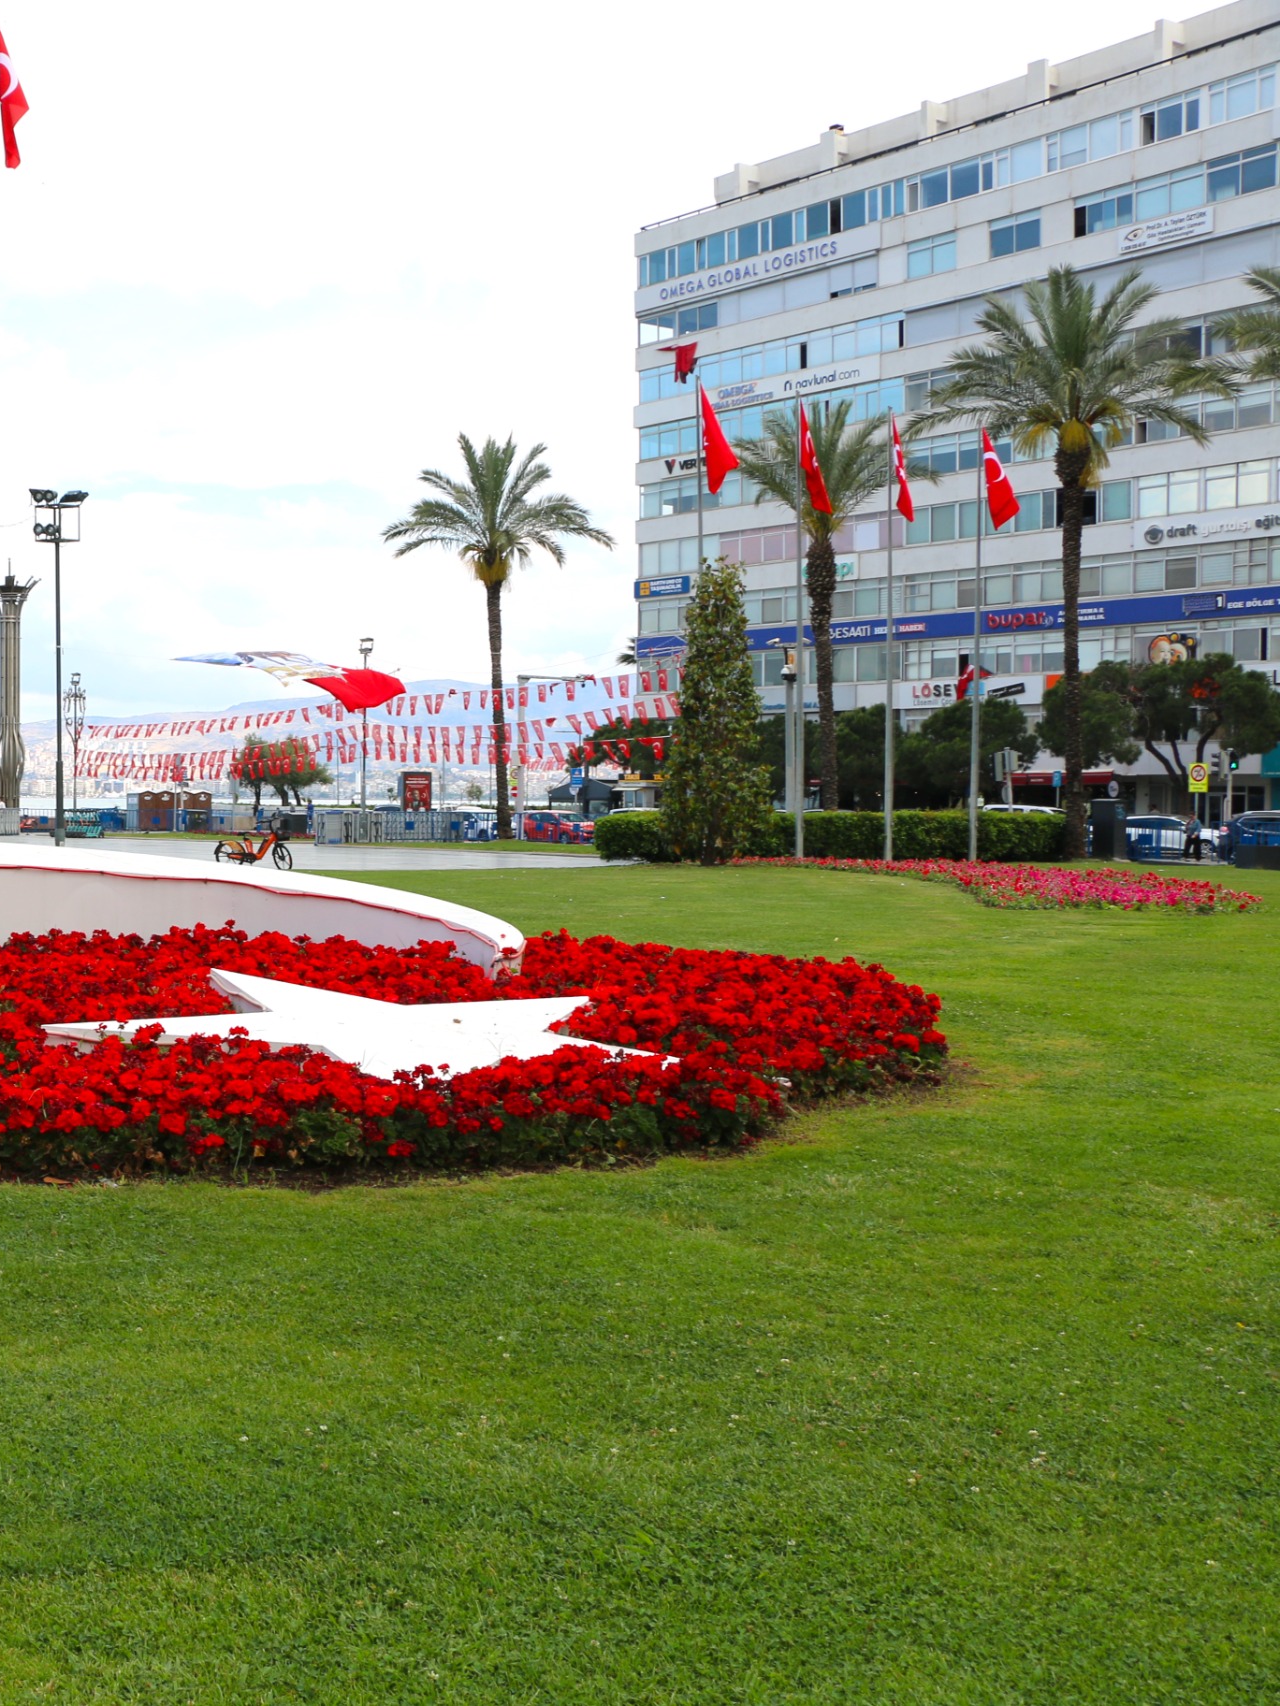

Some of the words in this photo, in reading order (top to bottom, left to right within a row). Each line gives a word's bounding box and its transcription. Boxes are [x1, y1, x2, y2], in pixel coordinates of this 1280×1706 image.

[659, 279, 705, 300] OMEGA
[707, 263, 759, 288] GLOBAL
[763, 240, 838, 273] LOGISTICS
[717, 384, 756, 399] OMEGA
[1166, 524, 1198, 538] draft
[1200, 520, 1252, 538] yurtdışı
[1227, 601, 1244, 609] EGE
[1245, 598, 1275, 608] BÖLGE
[987, 611, 1046, 630] bupar
